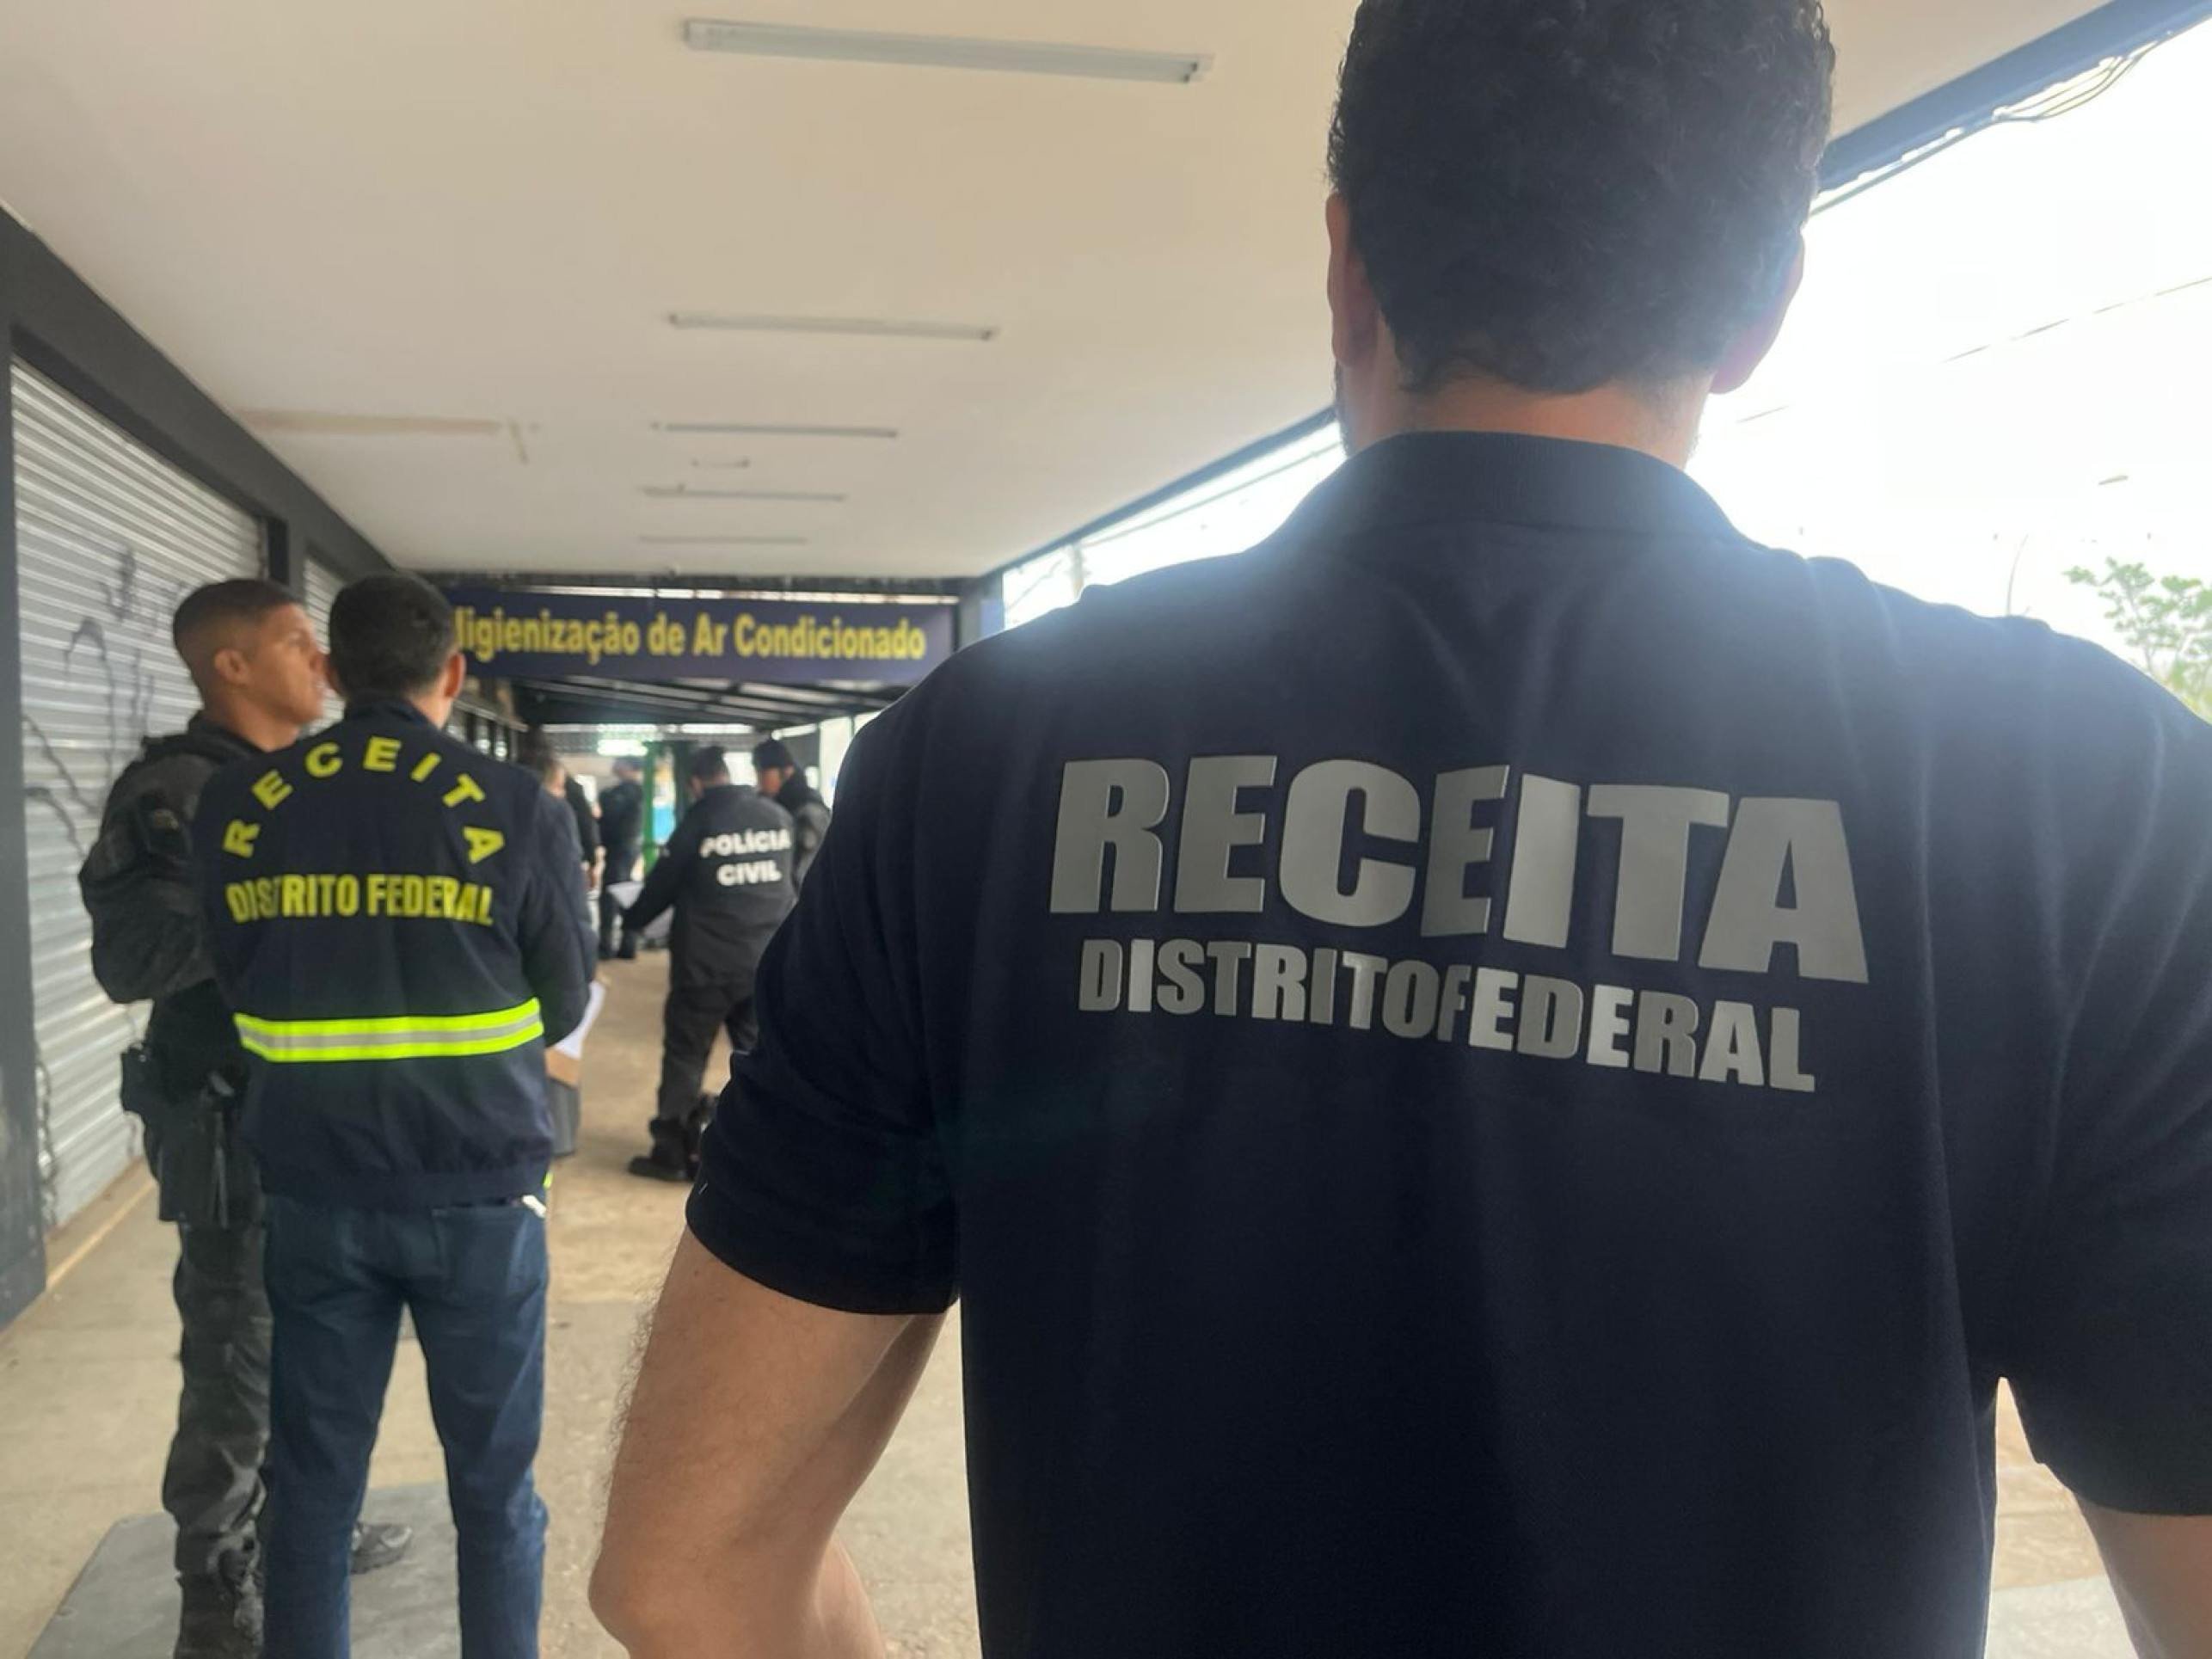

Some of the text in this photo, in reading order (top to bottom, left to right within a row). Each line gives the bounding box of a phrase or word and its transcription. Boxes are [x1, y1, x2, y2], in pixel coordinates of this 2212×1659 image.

[646, 611, 686, 656] de
[692, 612, 728, 657] Ar
[734, 615, 927, 661] Condicionado
[222, 735, 505, 864] RECEITA
[699, 828, 791, 858] POLÍCIA
[1049, 755, 1869, 983] RECEITA
[225, 873, 495, 925] DISTRITO FEDERAL
[716, 860, 783, 886] CIVIL
[1078, 937, 1816, 1092] DISTRITO FEDERAL
